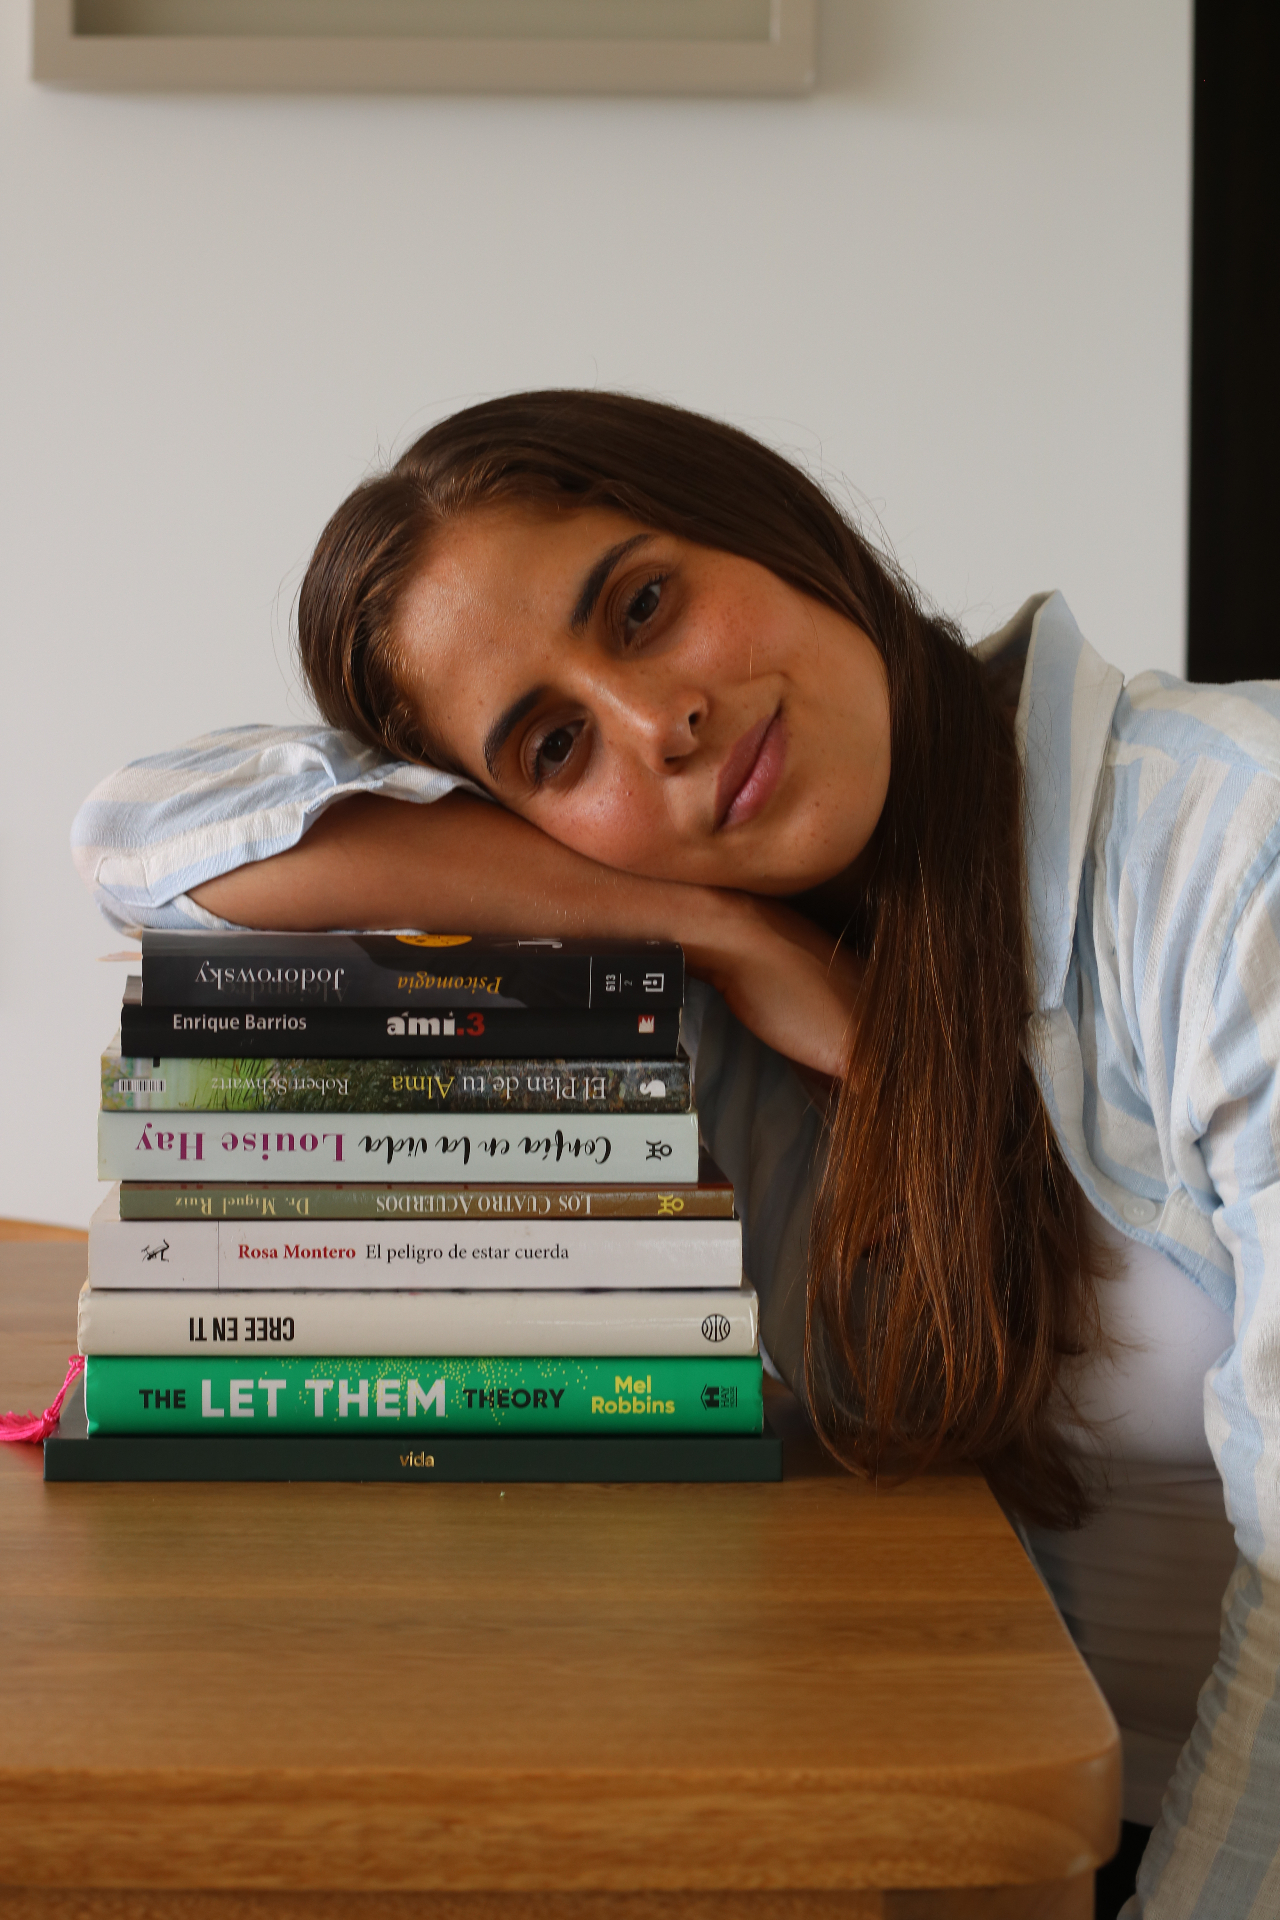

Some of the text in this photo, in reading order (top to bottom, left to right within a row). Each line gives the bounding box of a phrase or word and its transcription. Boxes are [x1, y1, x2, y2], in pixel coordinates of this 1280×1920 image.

[195, 960, 345, 991] Jodorowsky
[397, 971, 502, 994] Psicomagia
[606, 974, 616, 992] 613
[173, 1014, 307, 1033] Enrique Barrios
[211, 1077, 348, 1094] Robert Schwartz
[391, 1076, 606, 1099] El Plan de tu Alma
[135, 1123, 345, 1162] Louise Hay
[358, 1130, 611, 1166] Confía en la vida
[175, 1193, 310, 1214] Dr. Miguel Ruiz
[238, 1244, 569, 1264] Rosa Montero El peligro de estar cuerda
[189, 1317, 295, 1342] CREE EN TI
[139, 1379, 565, 1418] THE LET THEM THEORY
[592, 1375, 675, 1415] Mel Robbins
[400, 1451, 434, 1468] vida
